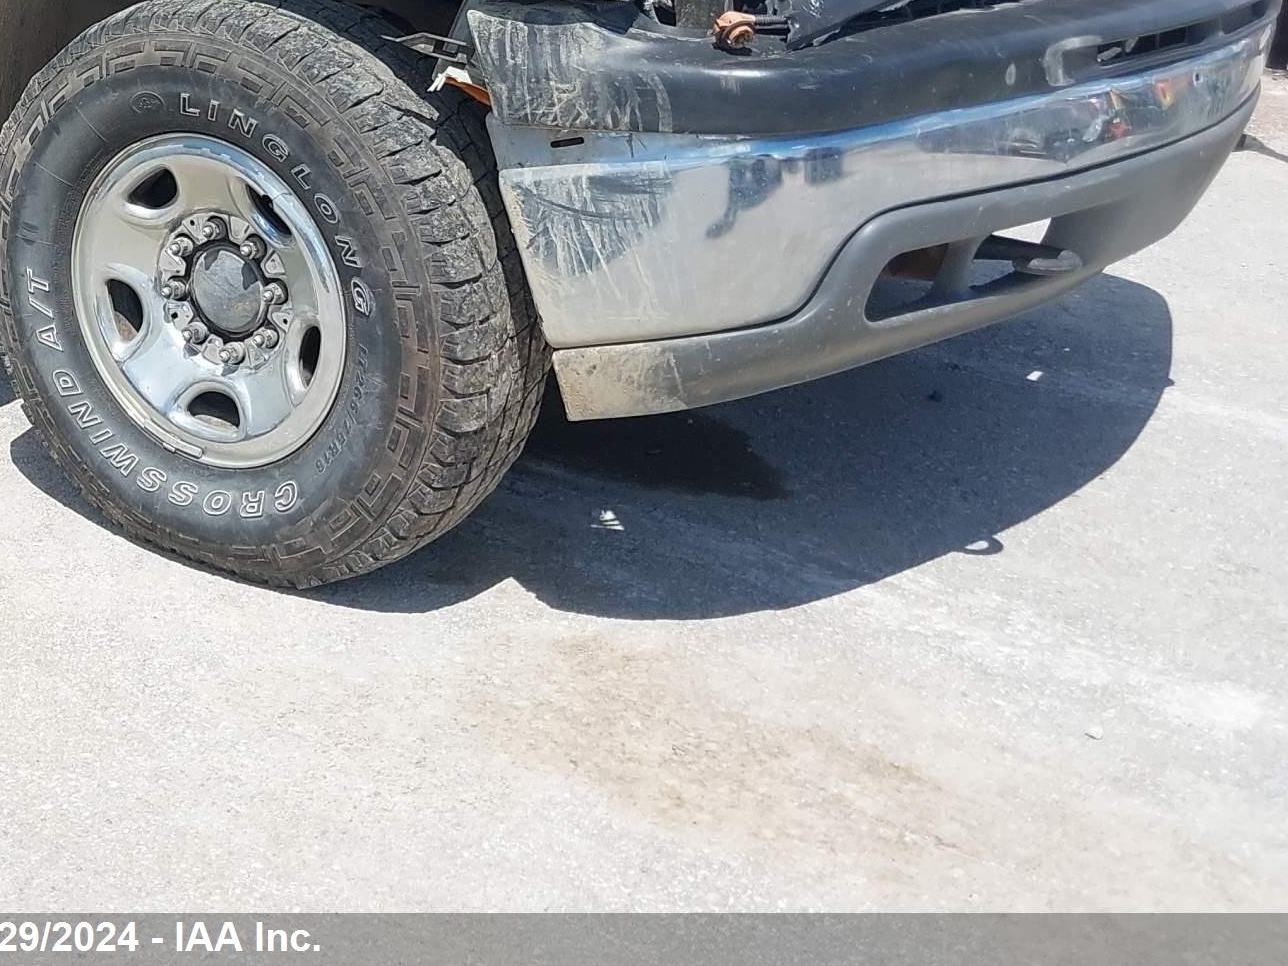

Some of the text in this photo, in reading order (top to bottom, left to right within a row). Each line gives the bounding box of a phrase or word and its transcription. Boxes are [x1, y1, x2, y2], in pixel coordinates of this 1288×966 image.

[179, 93, 372, 315] LINGLONG
[26, 267, 298, 518] CROSSWIND A/T
